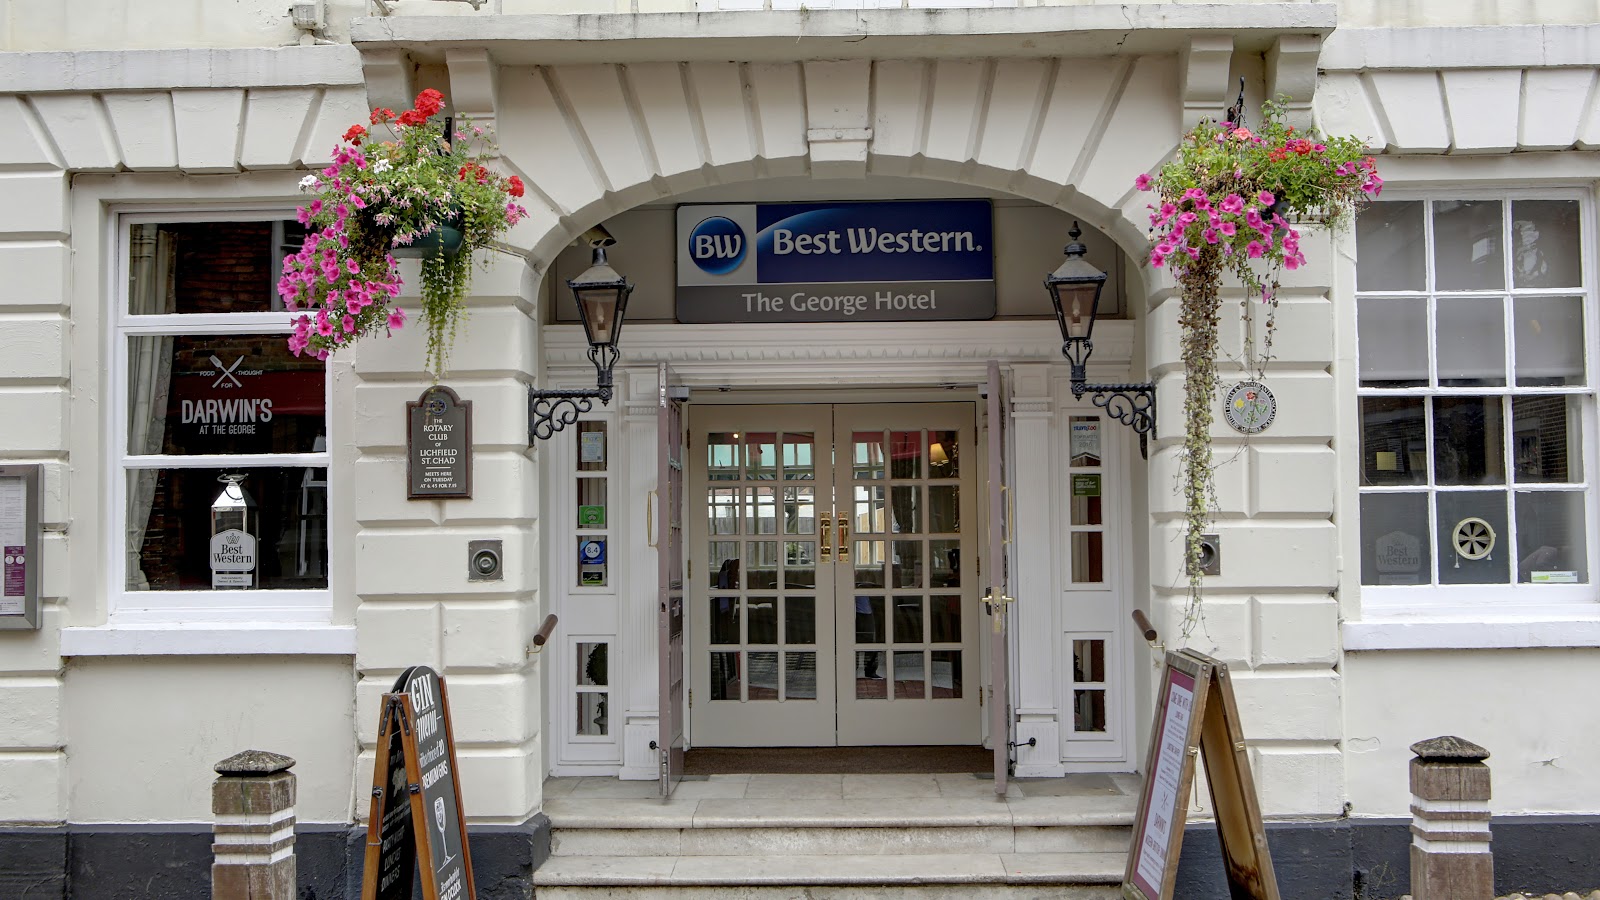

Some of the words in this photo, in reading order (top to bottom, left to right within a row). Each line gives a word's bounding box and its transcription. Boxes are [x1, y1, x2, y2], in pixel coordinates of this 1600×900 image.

[695, 233, 742, 260] BW
[773, 228, 842, 256] Best
[741, 292, 784, 313] The
[790, 291, 868, 316] George
[875, 289, 937, 311] Hotel
[181, 398, 273, 424] DARWIN'S
[199, 424, 210, 435] AT
[212, 424, 227, 435] THE
[228, 424, 256, 435] GEORGE
[423, 424, 454, 432] ROTARY
[428, 433, 448, 441] CLUB
[420, 449, 458, 457] LICHFIELD
[432, 457, 456, 465] CHAD
[221, 544, 243, 554] Best
[586, 546, 599, 554] 8.4
[1386, 545, 1408, 556] Best
[213, 553, 252, 563] Western
[1378, 555, 1419, 565] Western
[411, 673, 435, 713] GIN
